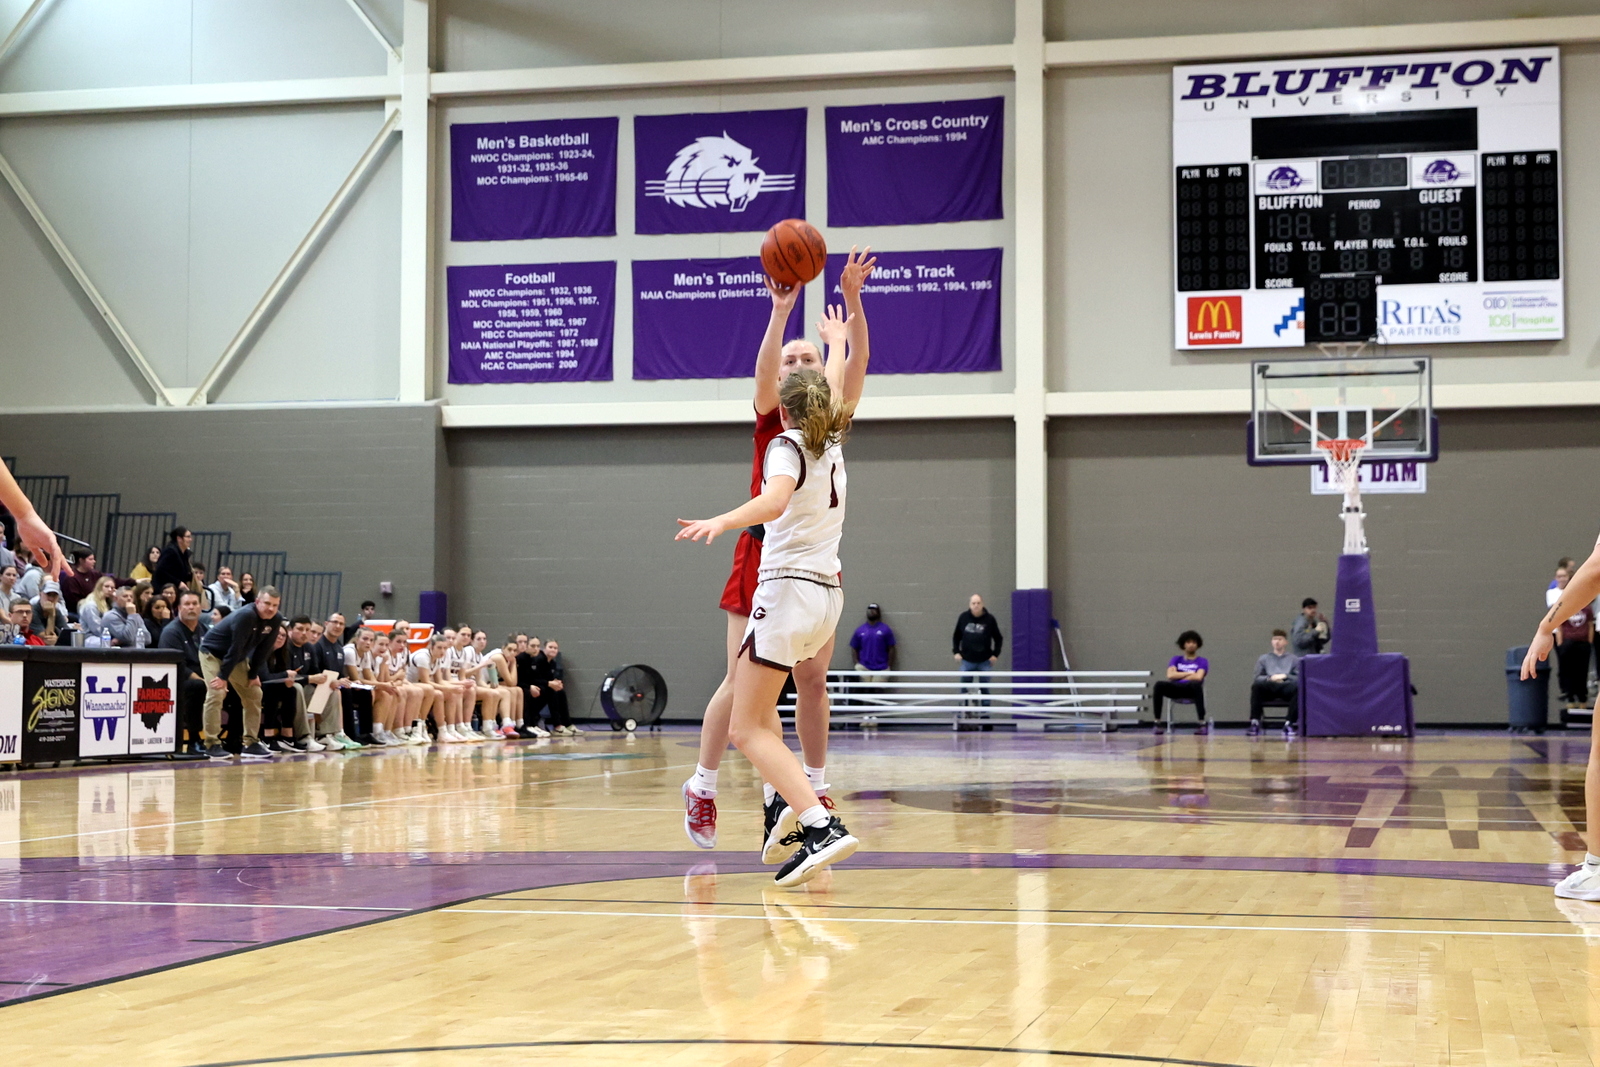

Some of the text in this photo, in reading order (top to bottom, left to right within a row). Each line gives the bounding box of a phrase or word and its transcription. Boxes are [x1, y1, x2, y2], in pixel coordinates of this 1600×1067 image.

[1180, 57, 1552, 100] BLUFFTON
[1203, 87, 1507, 112] UNIVERSITY
[840, 114, 989, 133] Men's Cross Country
[476, 133, 589, 150] Men's Basketball
[862, 132, 968, 146] AMC Champions: 1994
[470, 150, 595, 163] NWOC Champions: 1923-24,
[1486, 154, 1551, 166] PLYR FLS PTS
[497, 162, 569, 174] 1931-32, 1935-36
[1182, 166, 1242, 179] PLYR FLS PTS
[476, 172, 588, 186] MOC Champions: 1965-66
[1258, 195, 1323, 210] BLUFFTON
[1418, 189, 1463, 204] GUEST
[1348, 199, 1380, 210] PERIOD
[1264, 242, 1294, 252] FOULS
[1334, 238, 1395, 250] PLAYER FOUL
[1438, 236, 1468, 246] FOULS
[505, 272, 556, 284] Football
[870, 264, 955, 280] Men's Track
[1438, 272, 1468, 282] SCORE
[674, 272, 762, 286] Men's Tennis
[1265, 278, 1294, 288] SCORE
[469, 286, 592, 298] NWOC Champions: 1932, 1936
[860, 280, 992, 294] Champions: 1992, 1994, 1995
[640, 290, 668, 300] NAIA
[665, 290, 716, 300] Champions
[718, 288, 754, 300] (District
[461, 296, 600, 308] MOL Champions: 1951, 1956, 1957,
[544, 308, 562, 316] 1960
[473, 318, 586, 330] MOC Champions: 1962, 1967
[481, 328, 579, 340] HBCC Champions: 1972
[1190, 330, 1240, 340] Lewis Family
[1390, 326, 1460, 336] PARTNERS
[461, 342, 481, 350] NAIA
[482, 340, 516, 350] National
[517, 340, 552, 350] Playoffs:
[557, 340, 578, 348] 1987,
[484, 350, 574, 361] AMC Champions: 1994
[481, 360, 578, 371] HCAC Champions: 2000
[1371, 462, 1418, 482] DAM
[828, 463, 839, 508] 1
[753, 606, 766, 620] G
[137, 688, 171, 700] FARMERS
[84, 700, 126, 712] Wannemacher
[132, 700, 174, 714] EQUIPMENT
